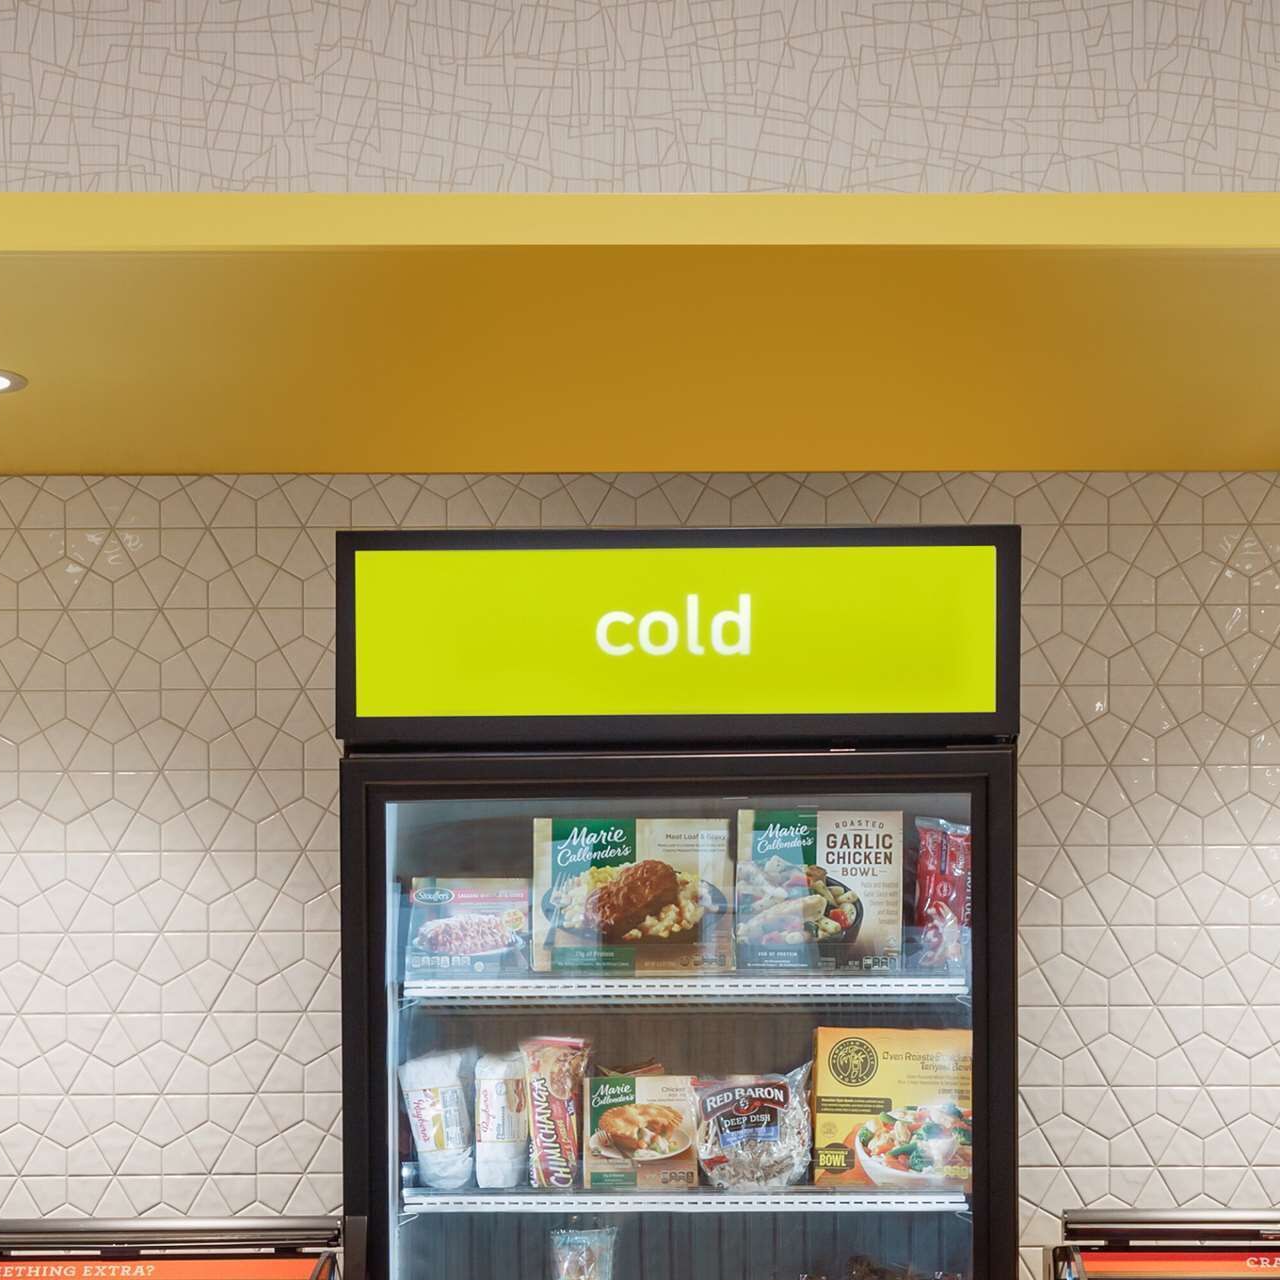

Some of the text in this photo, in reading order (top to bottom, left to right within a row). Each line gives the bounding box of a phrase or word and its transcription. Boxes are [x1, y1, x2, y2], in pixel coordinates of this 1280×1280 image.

[595, 594, 752, 656] cold
[761, 824, 810, 841] Marie
[834, 820, 885, 830] ROASTED
[558, 827, 627, 850] Marie
[758, 837, 814, 853] Callender's
[826, 834, 894, 850] GARLIC
[557, 845, 631, 866] Callender's
[825, 851, 893, 865] CHICKEN
[841, 867, 879, 877] BOWL
[593, 1083, 632, 1098] Marie
[705, 1084, 784, 1112] RED BARON
[724, 1113, 771, 1127] DEEP DISH
[533, 1078, 572, 1188] CHIMICHANGA
[819, 1154, 847, 1167] BOWL
[82, 1264, 155, 1278] EXTRA?
